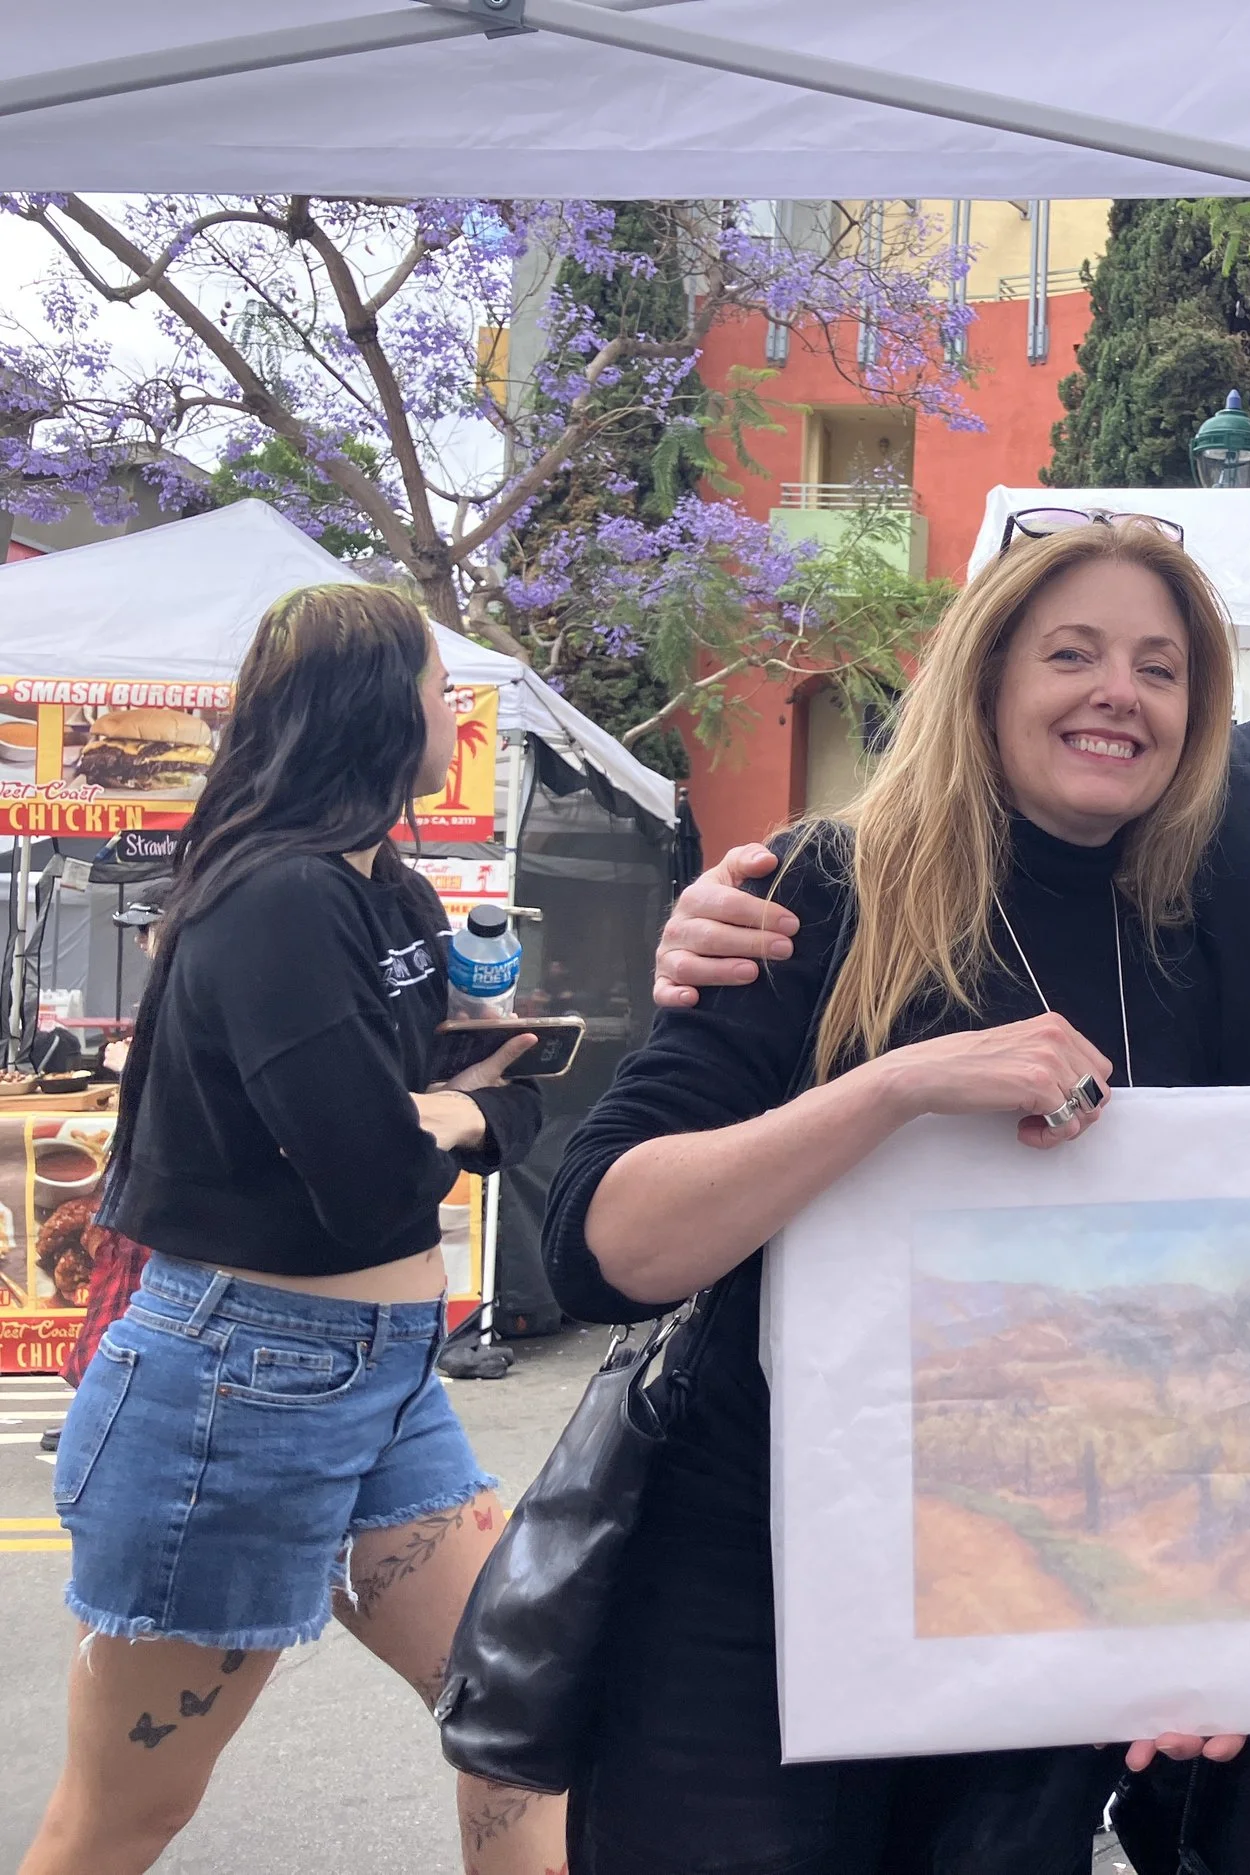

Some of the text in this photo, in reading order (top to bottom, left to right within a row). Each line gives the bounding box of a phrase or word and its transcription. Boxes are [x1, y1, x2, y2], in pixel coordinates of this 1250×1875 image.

[14, 680, 231, 708] SMASH BURGERS
[37, 782, 104, 802] Coast
[9, 803, 143, 832] CHICKEN
[126, 833, 177, 856] Strawb
[31, 1320, 84, 1339] Coast
[17, 1342, 75, 1367] CHIC
